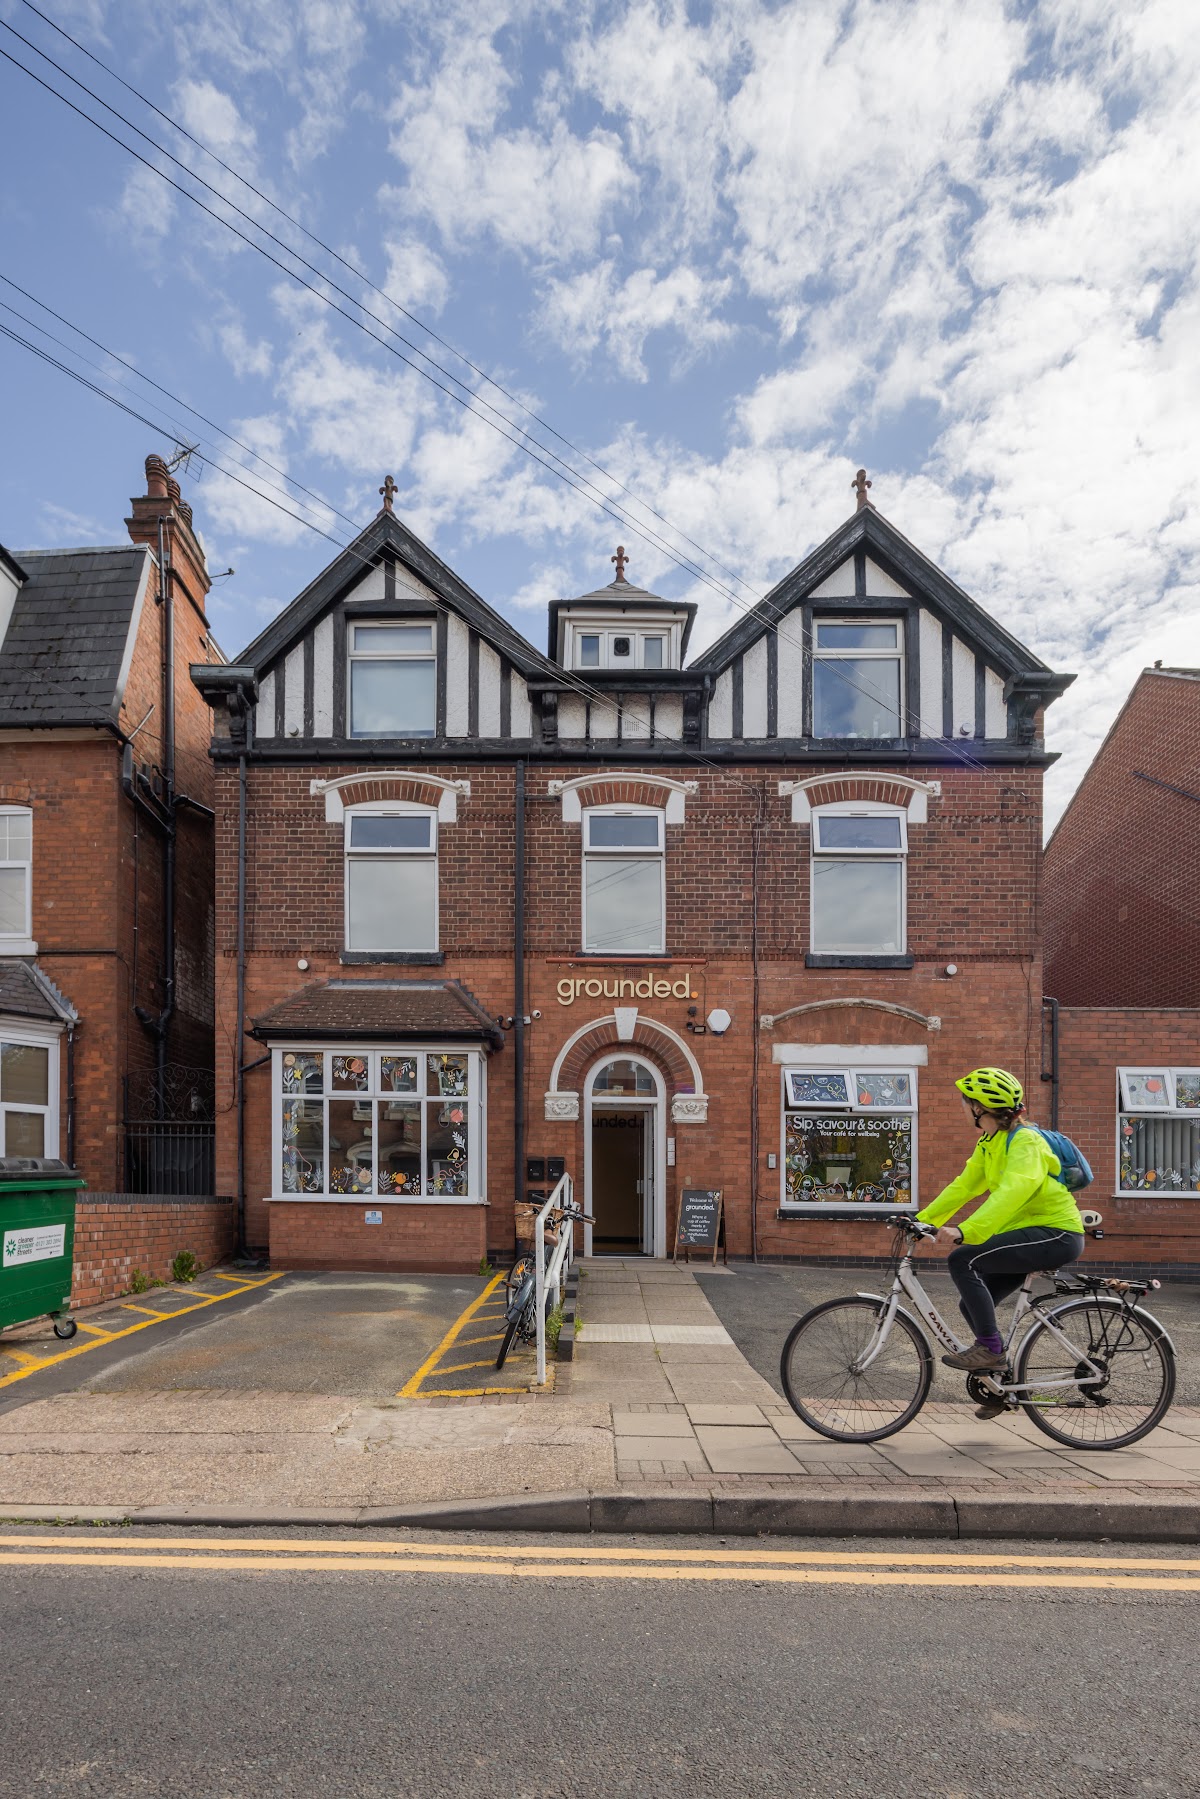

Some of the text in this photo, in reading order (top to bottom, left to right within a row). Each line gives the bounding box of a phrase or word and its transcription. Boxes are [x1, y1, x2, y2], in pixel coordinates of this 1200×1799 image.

[557, 973, 699, 1006] grounded.
[816, 1120, 857, 1130] savour
[857, 1119, 865, 1130] &
[868, 1118, 911, 1131] soothe
[928, 1312, 960, 1352] DAWES
